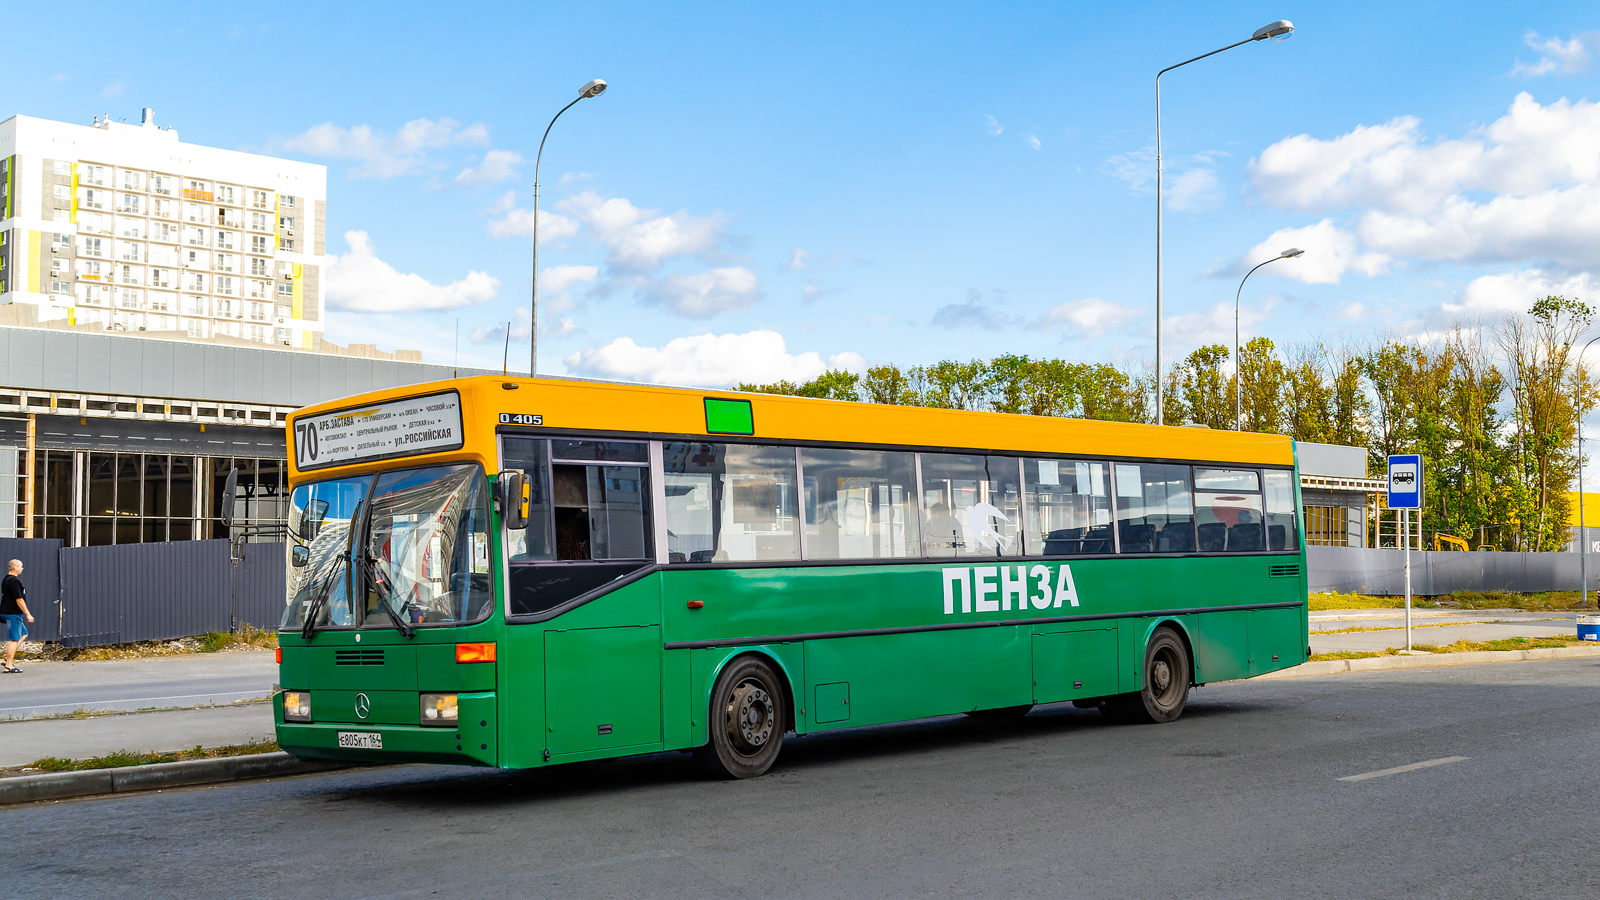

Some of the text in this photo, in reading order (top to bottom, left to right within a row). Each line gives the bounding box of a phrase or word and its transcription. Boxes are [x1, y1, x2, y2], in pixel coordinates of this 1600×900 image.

[512, 414, 543, 425] 405
[325, 432, 347, 442] АВТОВОКЗАЛ
[356, 425, 384, 437] ЦЕНТРАЛЬНЫЙ
[409, 420, 427, 429] ДЕТСКАЯ
[296, 422, 318, 463] 70
[357, 440, 380, 451] ДИЗЕЛЬНЫЙ
[942, 564, 1080, 615] ПЕНЗА
